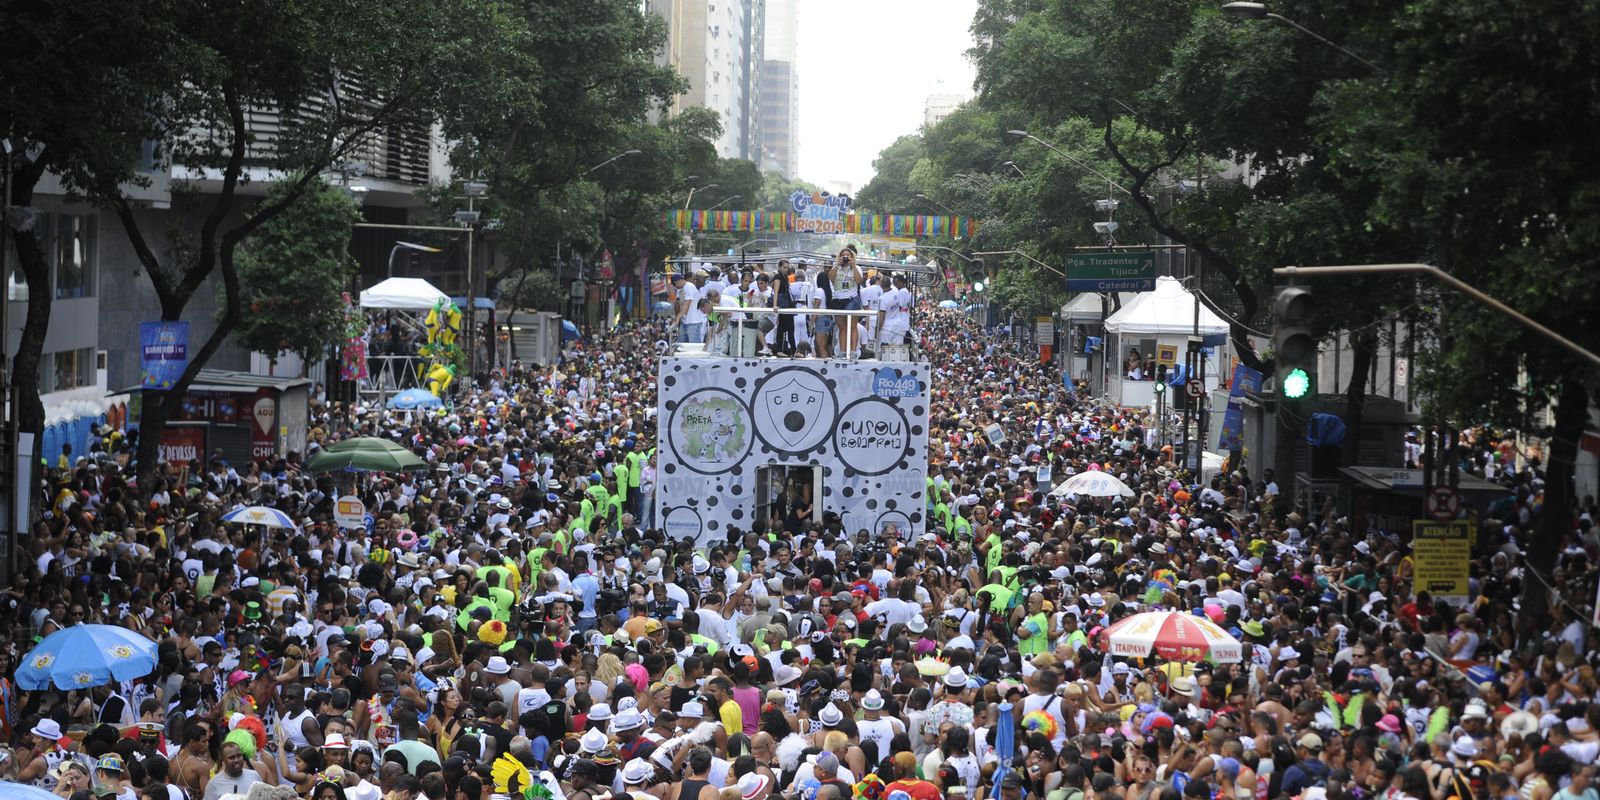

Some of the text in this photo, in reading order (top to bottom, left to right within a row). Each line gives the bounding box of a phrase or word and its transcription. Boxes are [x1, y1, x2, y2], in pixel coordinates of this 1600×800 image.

[810, 205, 838, 220] RUA
[815, 219, 843, 233] 2014
[1067, 258, 1086, 267] Pça.
[1111, 268, 1138, 276] Tijuca
[1099, 281, 1139, 289] Catedral
[878, 378, 916, 391] Rio 449
[774, 393, 816, 405] C B P
[686, 415, 712, 424] PRETA
[167, 446, 197, 461] DEVASSA
[1393, 472, 1410, 480] BRS
[1115, 643, 1146, 654] ITAIPAVA
